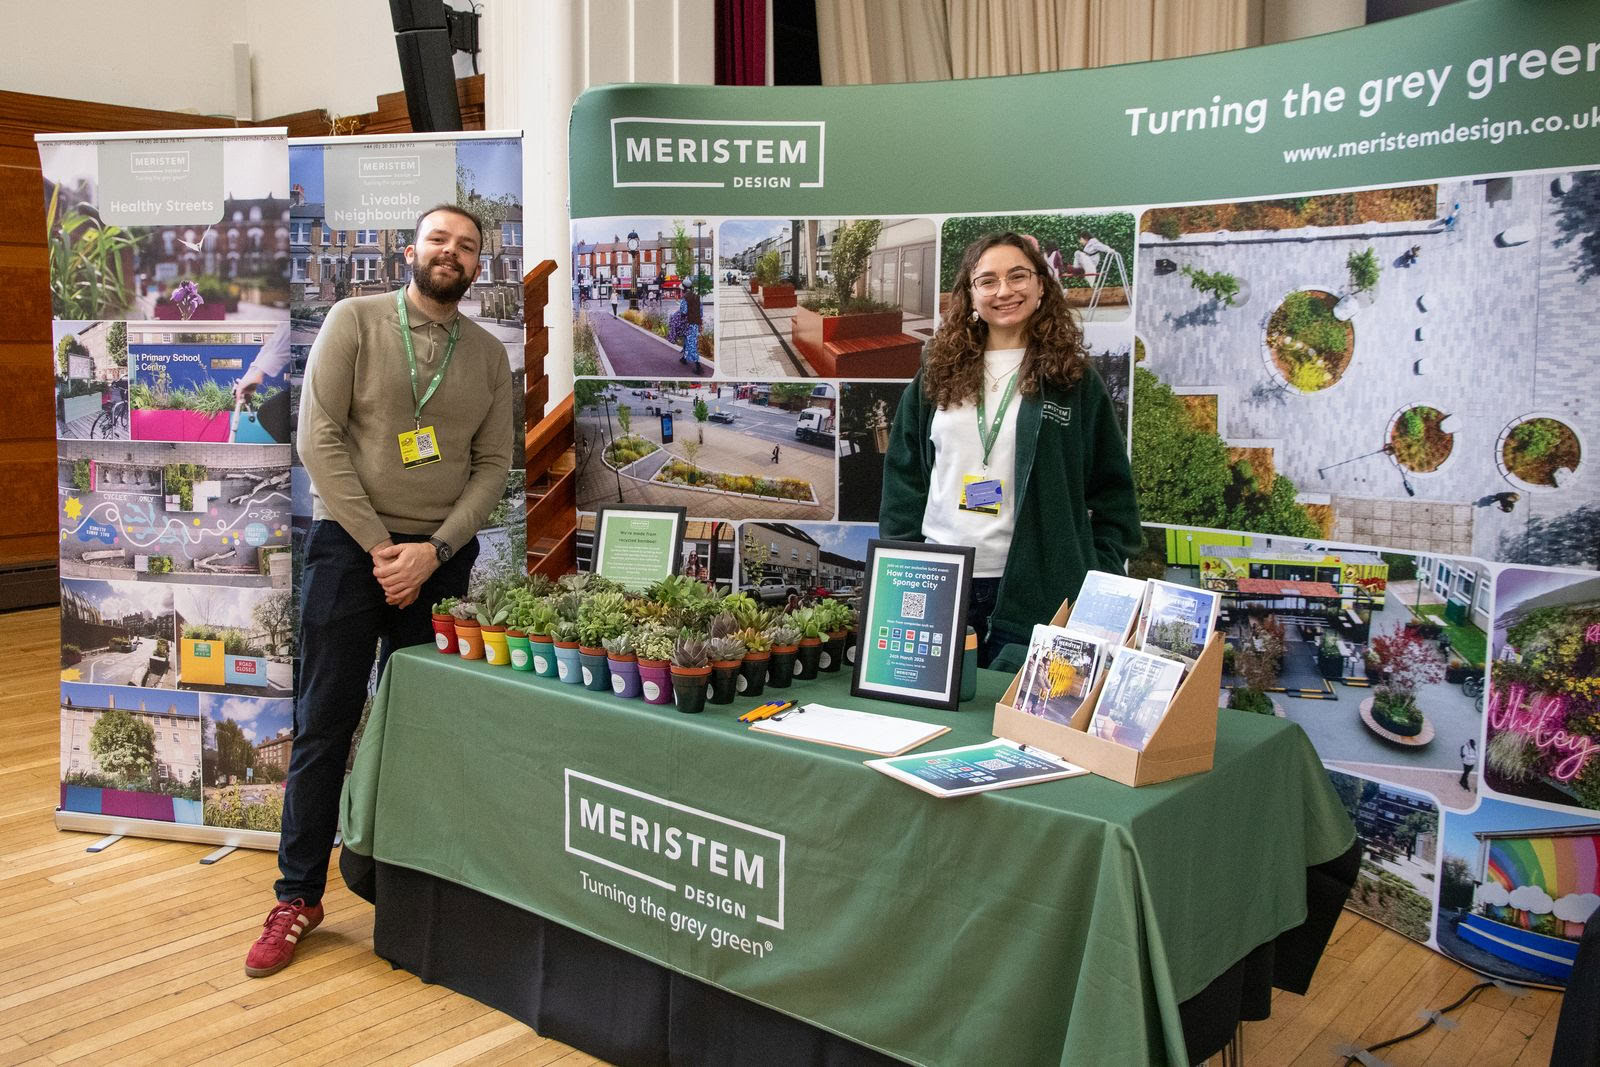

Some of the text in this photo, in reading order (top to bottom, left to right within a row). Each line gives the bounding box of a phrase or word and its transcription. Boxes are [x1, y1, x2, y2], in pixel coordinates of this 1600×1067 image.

[1125, 96, 1267, 137] Turning
[1282, 82, 1345, 119] the
[1359, 64, 1453, 118] grey
[1283, 106, 1600, 164] www.meristemdesign.co.uk
[626, 137, 807, 164] MERISTEM
[135, 156, 185, 166] MERISTEM
[363, 161, 415, 170] MERISTEM
[733, 176, 791, 189] DESIGN
[361, 192, 420, 206] Liveable
[110, 199, 214, 215] Healthy Streets
[334, 207, 424, 224] Neighbourho
[141, 353, 171, 363] Primary
[172, 353, 200, 362] School
[1043, 403, 1068, 417] ERISTEM
[886, 569, 904, 577] How
[892, 578, 938, 591] Sponge City
[580, 798, 764, 889] MERISTEM
[580, 870, 637, 913] Turning
[640, 897, 667, 921] the
[670, 911, 707, 941] grey
[685, 885, 746, 919] DESIGN
